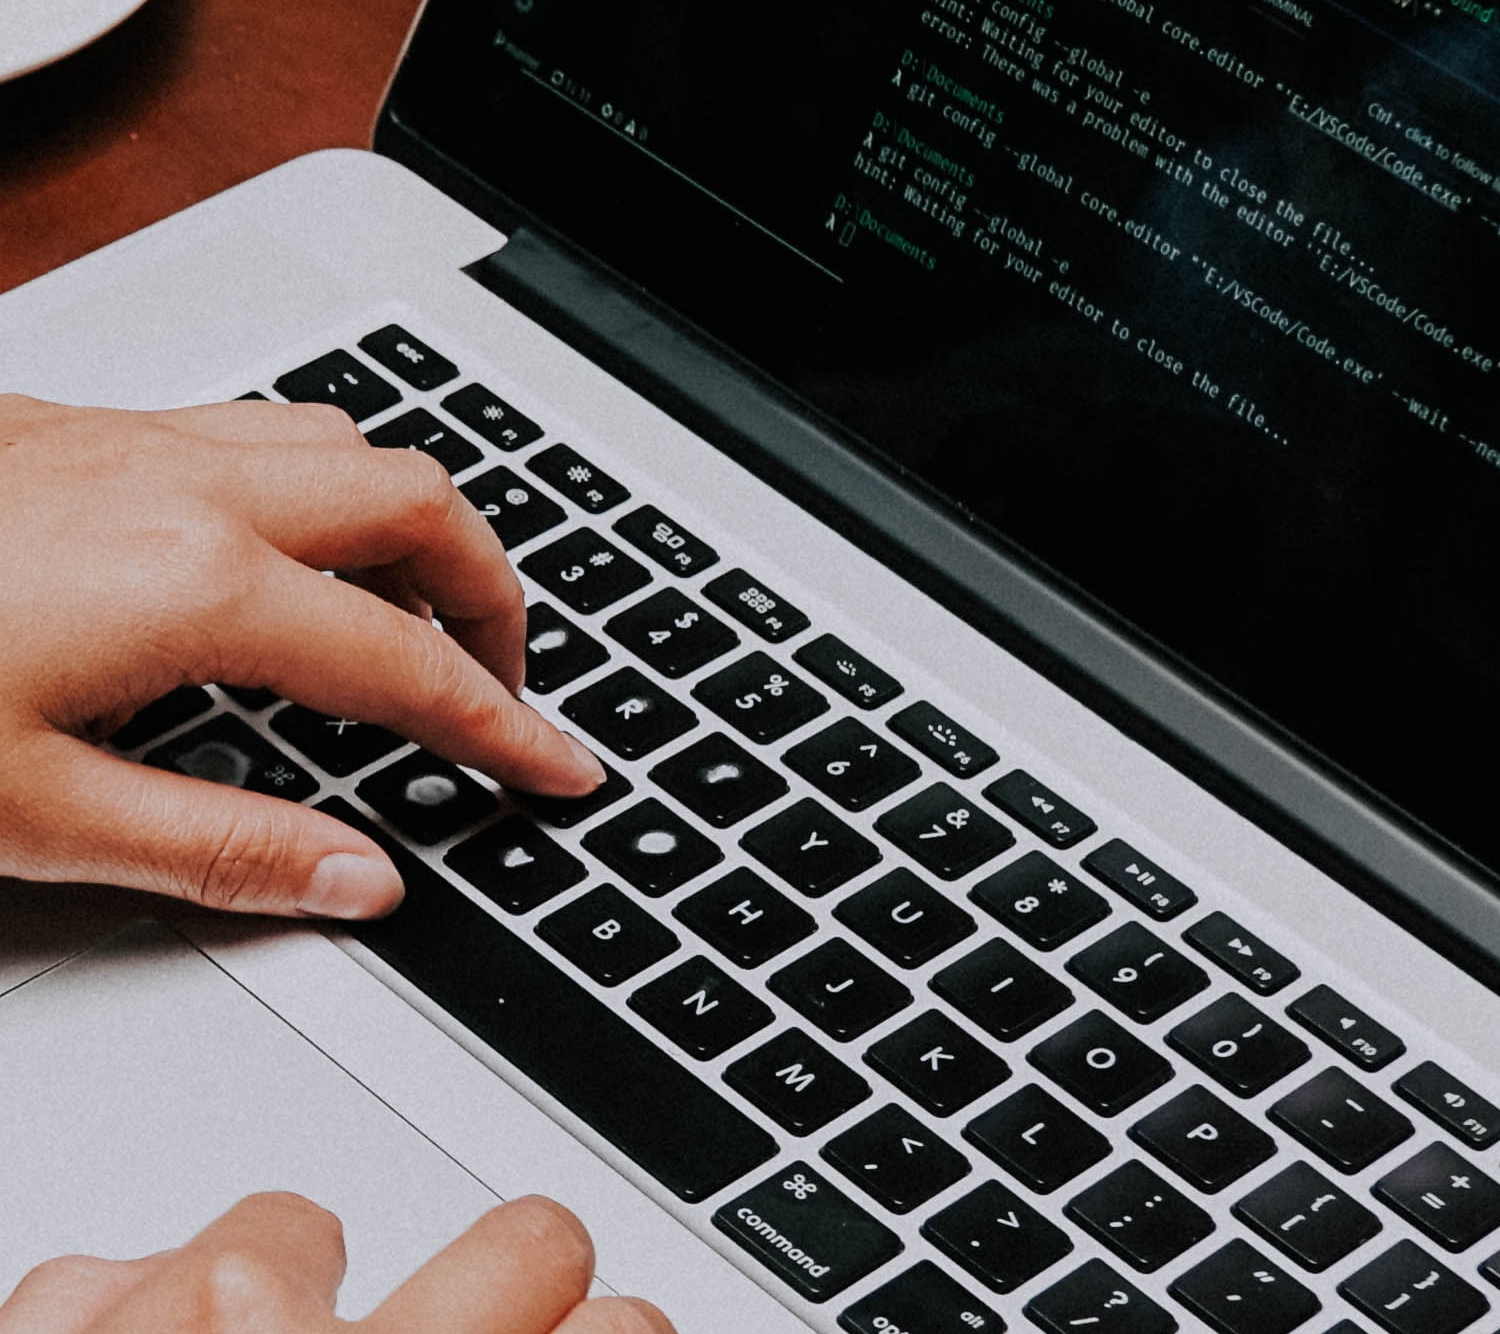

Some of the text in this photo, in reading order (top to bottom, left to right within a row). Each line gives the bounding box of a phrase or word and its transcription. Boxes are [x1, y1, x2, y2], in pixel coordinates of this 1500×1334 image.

[990, 0, 1046, 44] config
[1054, 40, 1123, 88] --global
[1132, 88, 1151, 105] -e
[1161, 20, 1264, 87] core.editor
[920, 9, 1294, 247] error: There was a problem with the editor
[980, 17, 1044, 70] Waiting
[1051, 59, 1080, 87] for
[1083, 83, 1124, 114] your
[1128, 111, 1186, 152] editor
[1192, 148, 1213, 171] to
[1218, 166, 1267, 204] close
[1274, 198, 1305, 227] the
[1311, 220, 1374, 273] file...
[1366, 101, 1394, 125] Ctrl
[1403, 126, 1434, 151] click
[1433, 142, 1451, 161] to
[1450, 151, 1493, 185] follow
[877, 145, 1070, 274] git config --global -e
[906, 82, 936, 108] git
[941, 104, 996, 148] config
[1005, 146, 1073, 194] --global
[1080, 191, 1181, 261] core.editor
[1392, 390, 1448, 432] --wait
[852, 151, 1288, 445] hint: Waiting for your editor to close the file...
[395, 341, 425, 364] esc
[560, 565, 585, 582] 3
[648, 630, 672, 645] 4
[615, 697, 645, 720] R
[735, 692, 762, 709] 5
[826, 760, 851, 776] 6
[953, 750, 971, 765] F6
[918, 824, 947, 840] 7
[1050, 821, 1071, 834] F7
[800, 831, 829, 851] Y
[1014, 895, 1040, 914] 8
[1150, 892, 1170, 907] F8
[728, 899, 764, 925] H
[891, 900, 924, 924] U
[592, 918, 622, 940] B
[825, 978, 854, 993] J
[1112, 967, 1138, 983] 9
[1252, 967, 1272, 981] F9
[682, 989, 719, 1016] N
[919, 1046, 955, 1071] K
[1351, 1038, 1378, 1056] F10
[775, 1063, 816, 1092] M
[1021, 1122, 1045, 1145] L
[1186, 1122, 1219, 1141] P
[1463, 1118, 1488, 1135] F11
[734, 1202, 831, 1281] command
[959, 1307, 986, 1330] alt
